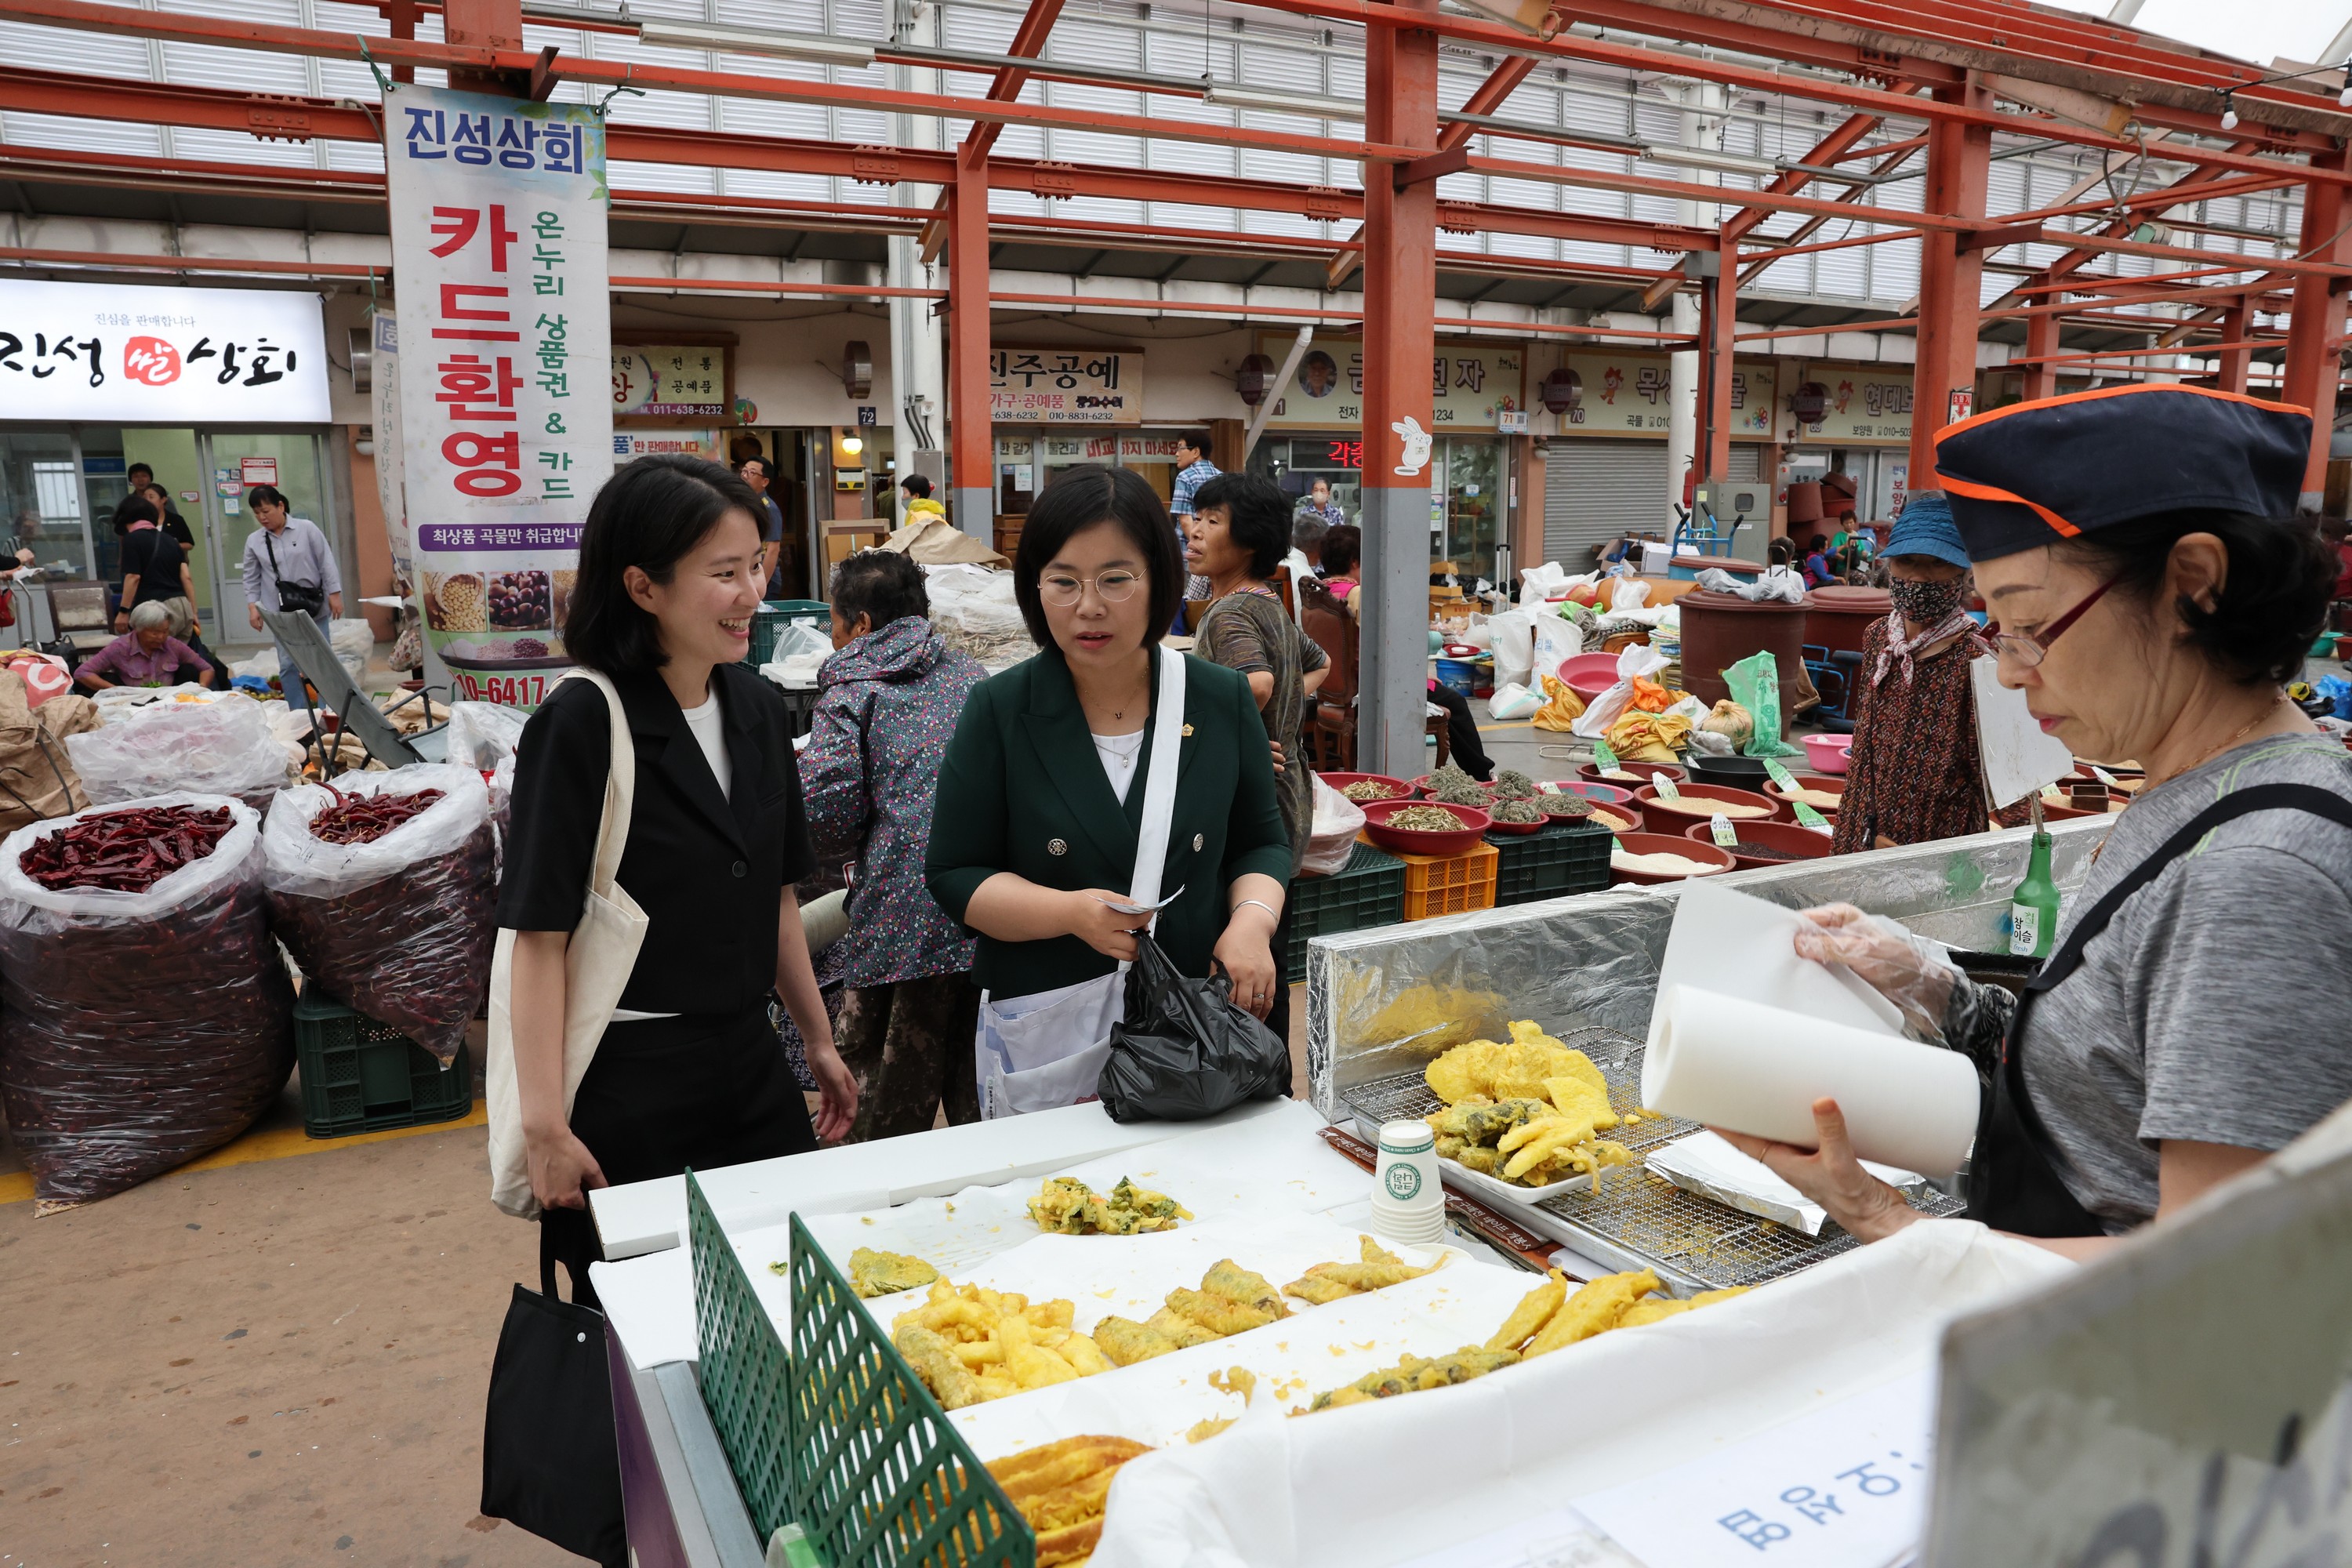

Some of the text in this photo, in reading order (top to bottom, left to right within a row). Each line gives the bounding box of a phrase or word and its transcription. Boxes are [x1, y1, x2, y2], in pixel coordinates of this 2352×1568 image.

[404, 107, 584, 175] 진성상회
[531, 211, 565, 297] 온누리
[94, 313, 196, 328] 진심을 판매합니다
[428, 203, 524, 498] 카드환영
[535, 312, 571, 398] 상품권
[128, 343, 173, 383] 쌀
[187, 337, 296, 387] 상회
[671, 380, 712, 394] 공예품
[653, 405, 722, 415] 011-638-6232
[1049, 412, 1113, 420] 010-8831-6232
[1338, 406, 1359, 419] 전자
[1573, 409, 1584, 423] 70
[861, 412, 874, 423] 72
[1504, 414, 1513, 424] 71
[1627, 415, 1643, 426] 곡물
[1853, 426, 1872, 437] 보양원
[648, 441, 699, 453] 판매합니다
[1048, 441, 1080, 456] 물건과
[538, 451, 575, 500] 카드
[432, 527, 476, 547] 최상품
[479, 527, 522, 546] 곡물만
[2013, 944, 2027, 953] fresh
[1483, 1217, 1509, 1232] 테이프
